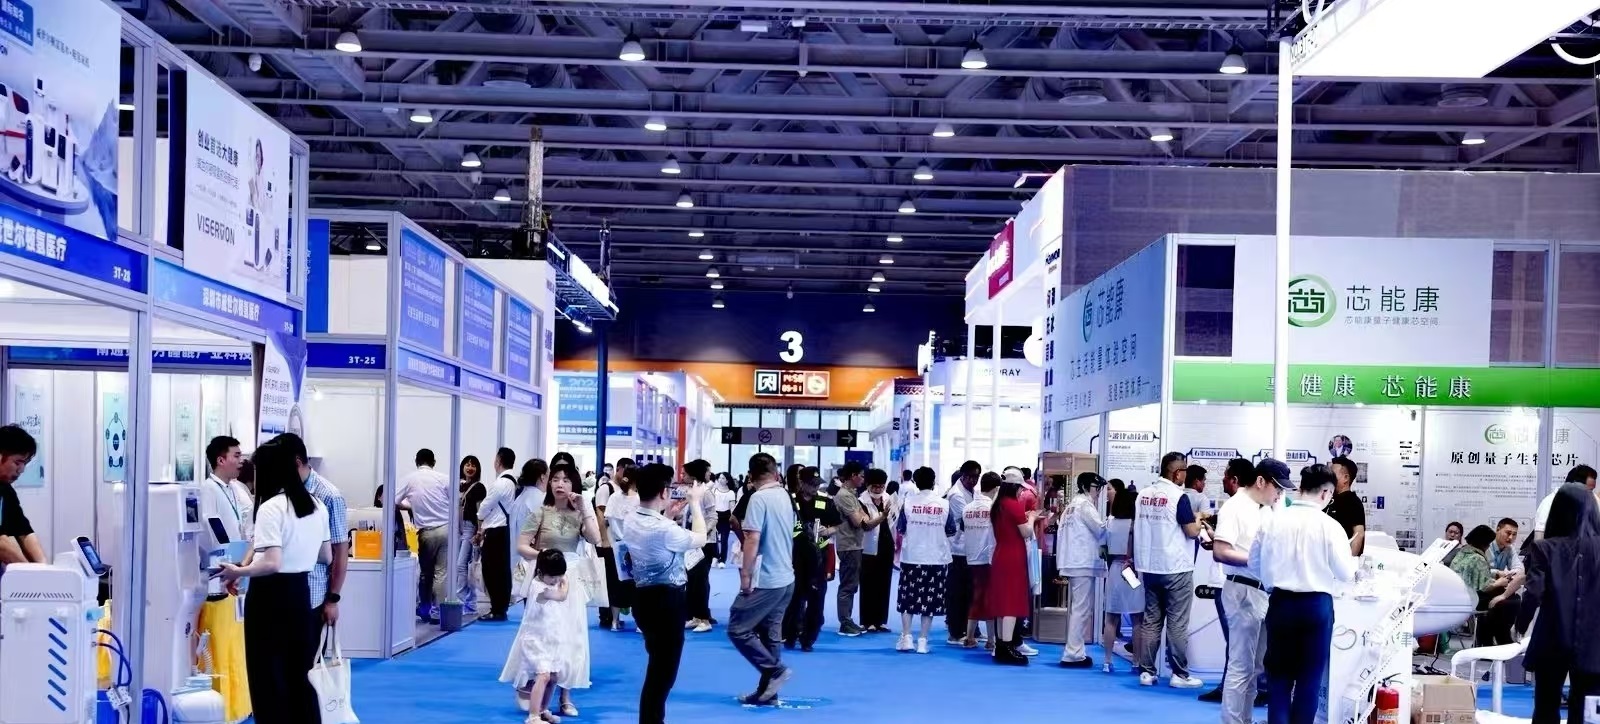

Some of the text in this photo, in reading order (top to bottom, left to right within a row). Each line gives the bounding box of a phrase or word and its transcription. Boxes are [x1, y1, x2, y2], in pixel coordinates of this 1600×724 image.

[1346, 285, 1440, 313] 芯能康
[779, 330, 804, 363] 3
[348, 356, 376, 364] 3T-25
[1382, 375, 1471, 399] 芯能康
[912, 505, 943, 515] 芯能康
[1141, 496, 1168, 507] 芯能康
